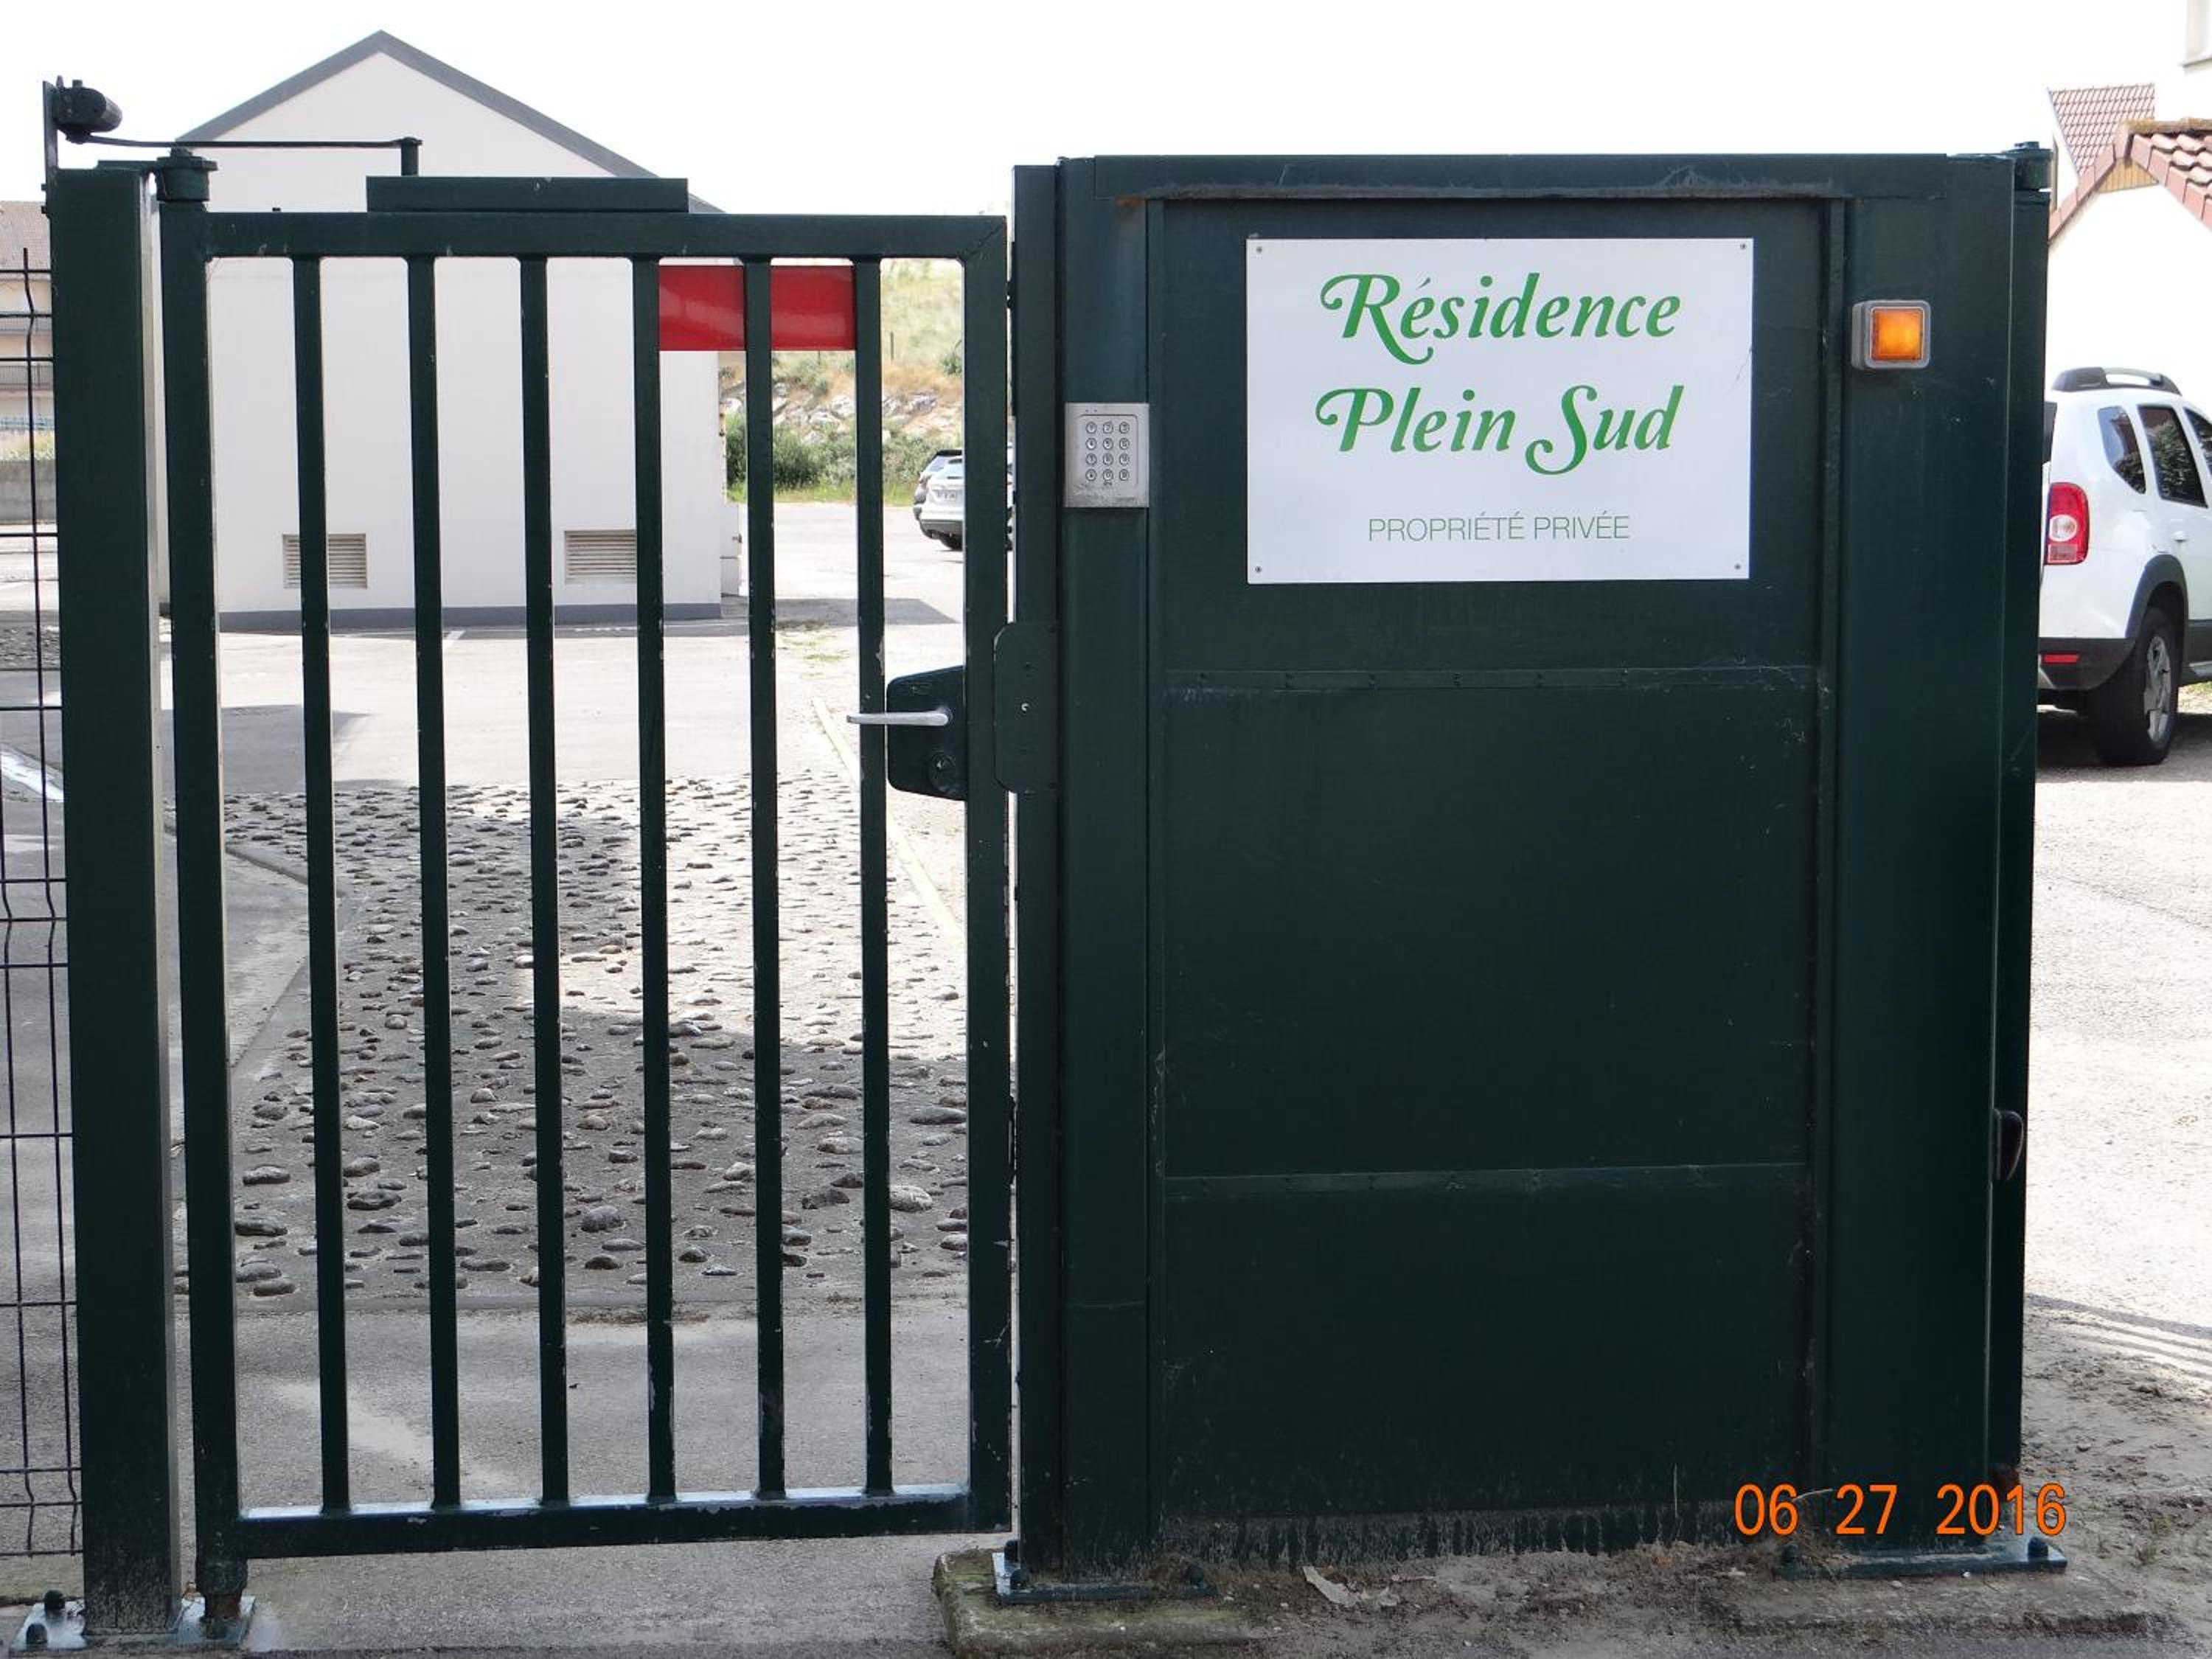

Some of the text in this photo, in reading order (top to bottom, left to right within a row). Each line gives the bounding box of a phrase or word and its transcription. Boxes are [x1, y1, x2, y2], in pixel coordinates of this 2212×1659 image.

[1320, 272, 1680, 365] Résidence
[1315, 385, 1684, 476] Plein Sud
[1368, 509, 1630, 541] PROPRIÉTÉ PRIVÉE
